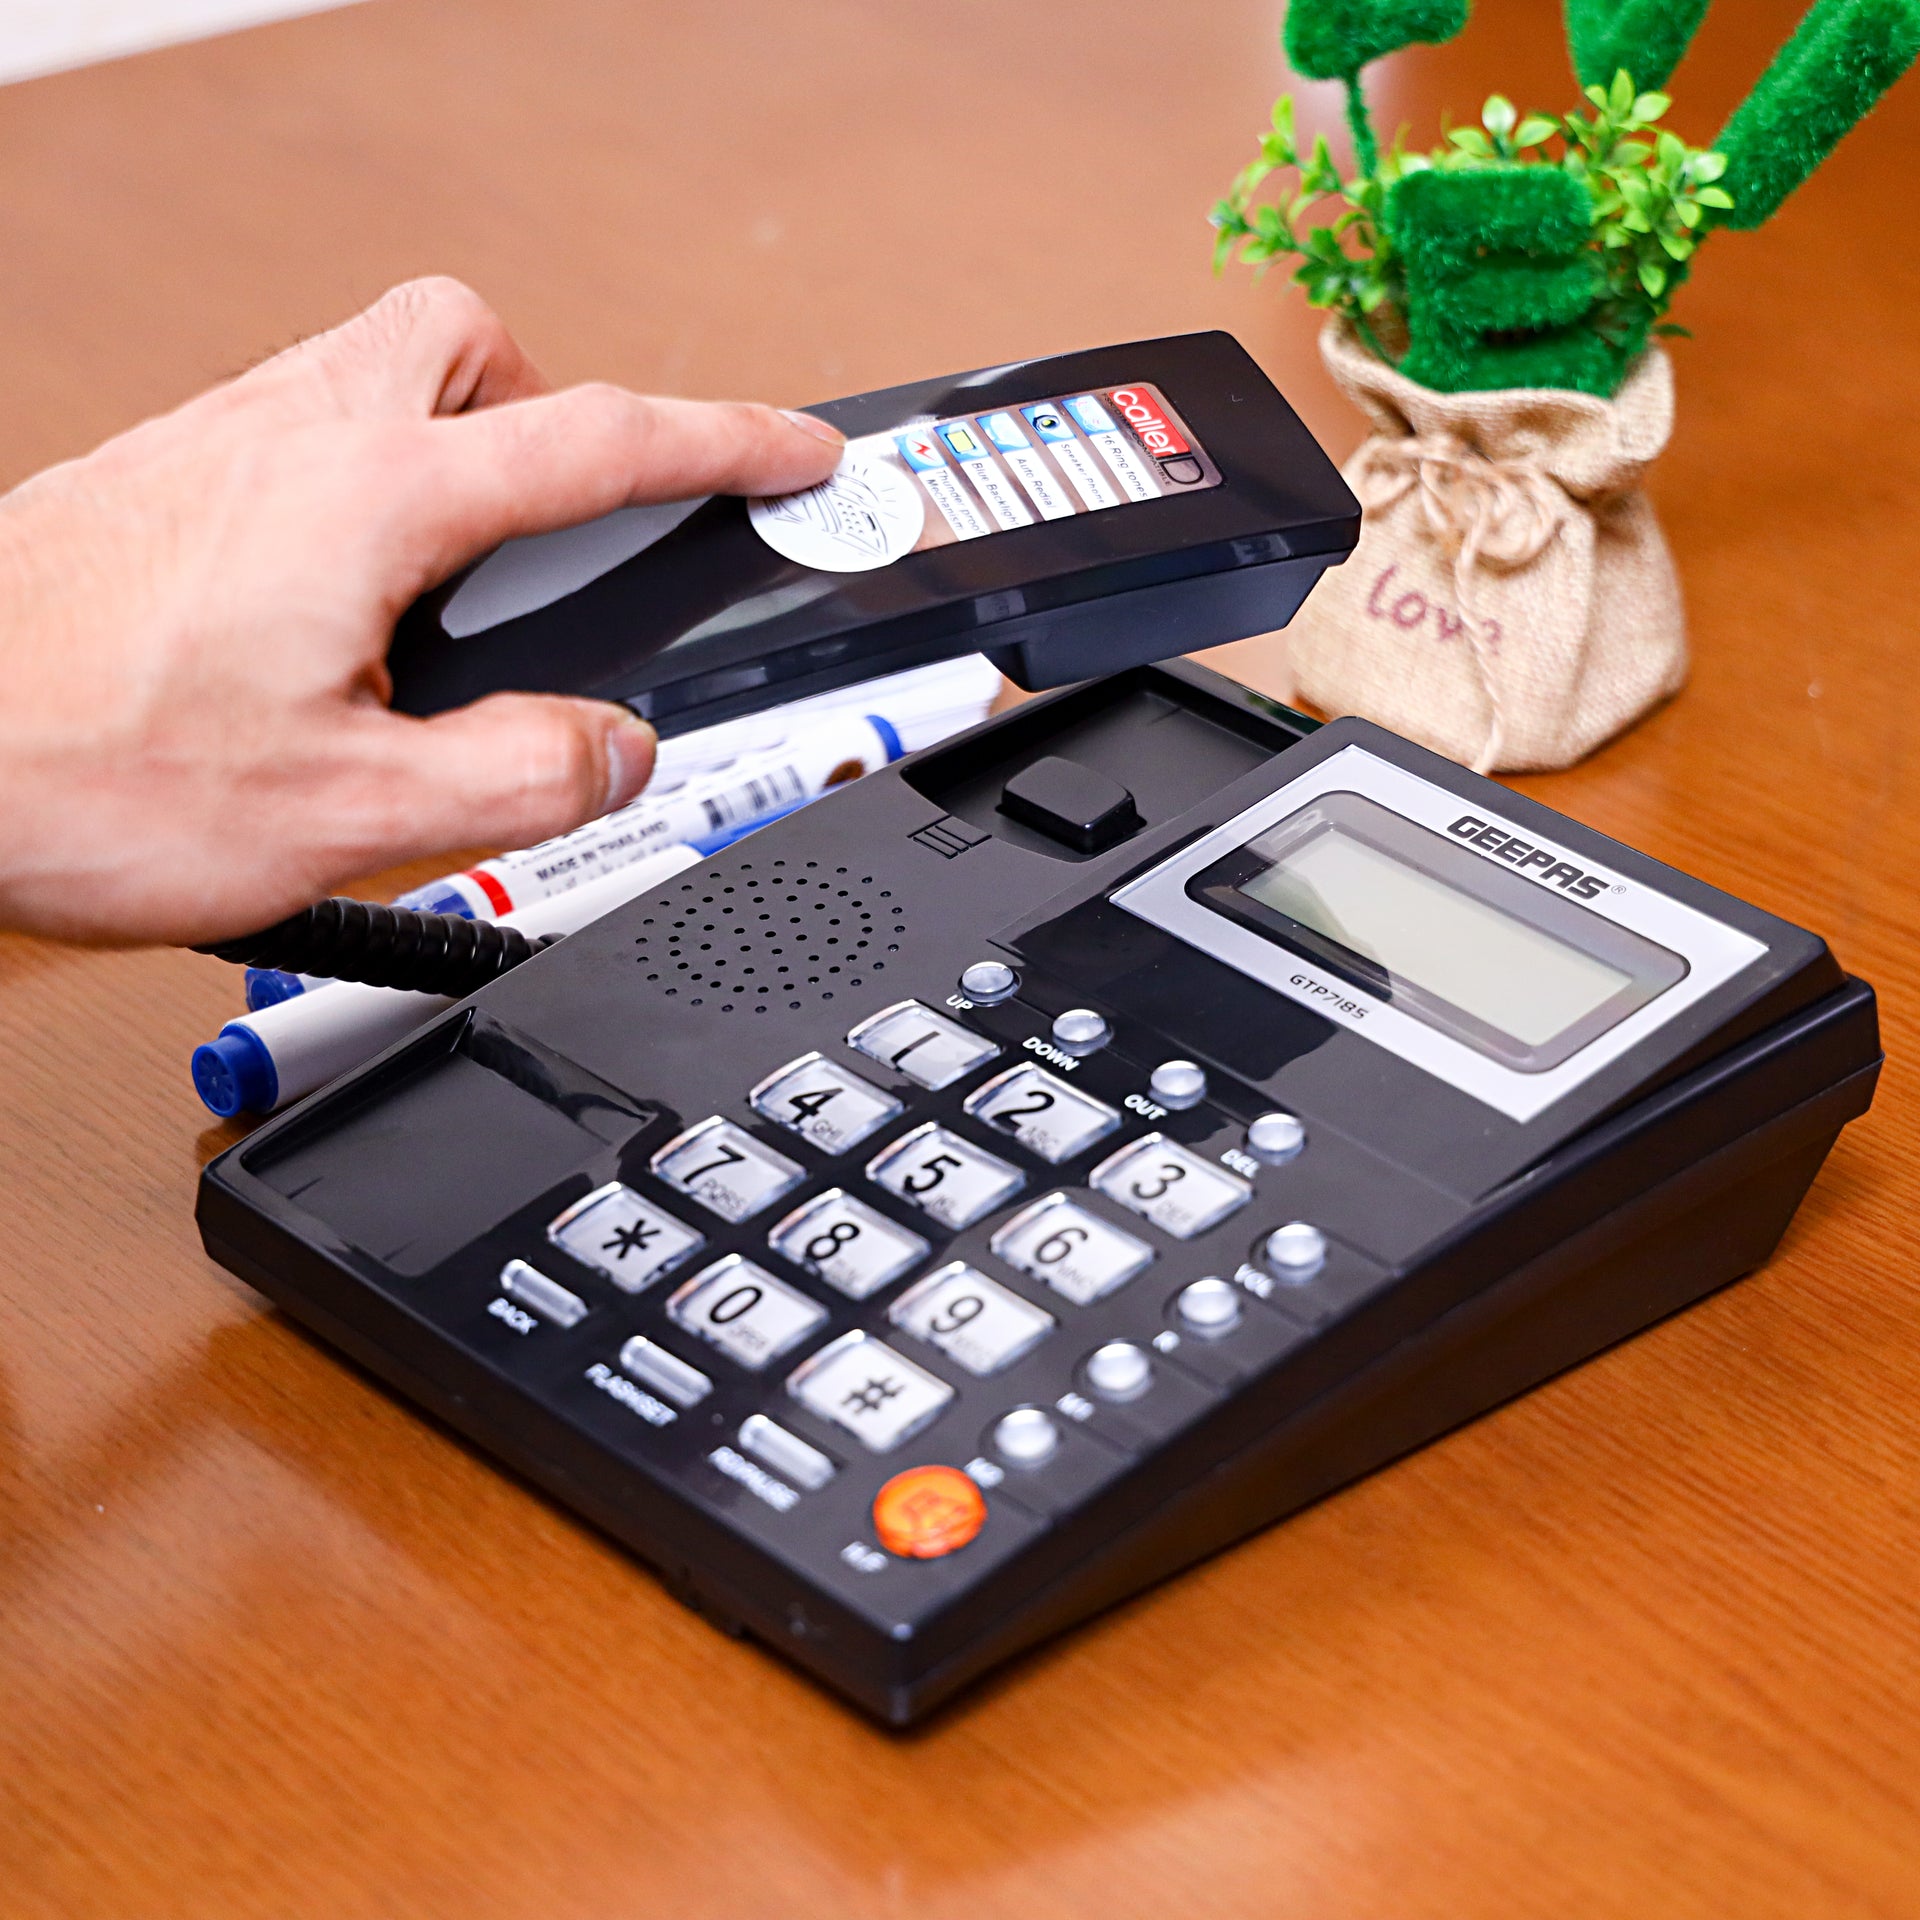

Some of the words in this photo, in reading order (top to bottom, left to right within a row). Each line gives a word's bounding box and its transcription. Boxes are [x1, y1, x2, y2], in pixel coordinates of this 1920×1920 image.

[1061, 443, 1088, 477] Speaker
[1112, 444, 1130, 470] Ring
[1127, 471, 1148, 498] tones
[1130, 431, 1172, 487] COMPATIBLE
[936, 469, 965, 507] Thunder
[960, 507, 987, 536] proof
[971, 462, 989, 482] Blue
[986, 483, 1020, 527] Backlight
[1016, 457, 1035, 479] Auto
[1033, 480, 1056, 510] Redial
[926, 478, 964, 532] Mechanism
[1446, 815, 1611, 900] GEEPAS
[945, 993, 974, 1012] UP
[1289, 974, 1369, 1020] GTP7185
[1022, 1035, 1081, 1072] DOWN
[788, 1087, 844, 1125] 4
[990, 1091, 1056, 1130] 2
[1123, 1093, 1169, 1121] OUT
[683, 1144, 746, 1185] 7
[902, 1154, 962, 1194] 5
[1131, 1163, 1187, 1200] 3
[1219, 1147, 1260, 1179] DEL
[805, 1222, 860, 1260] 8
[1034, 1226, 1089, 1265] 6
[487, 1297, 539, 1335] BACK
[709, 1286, 763, 1325] 0
[929, 1295, 985, 1333] 9
